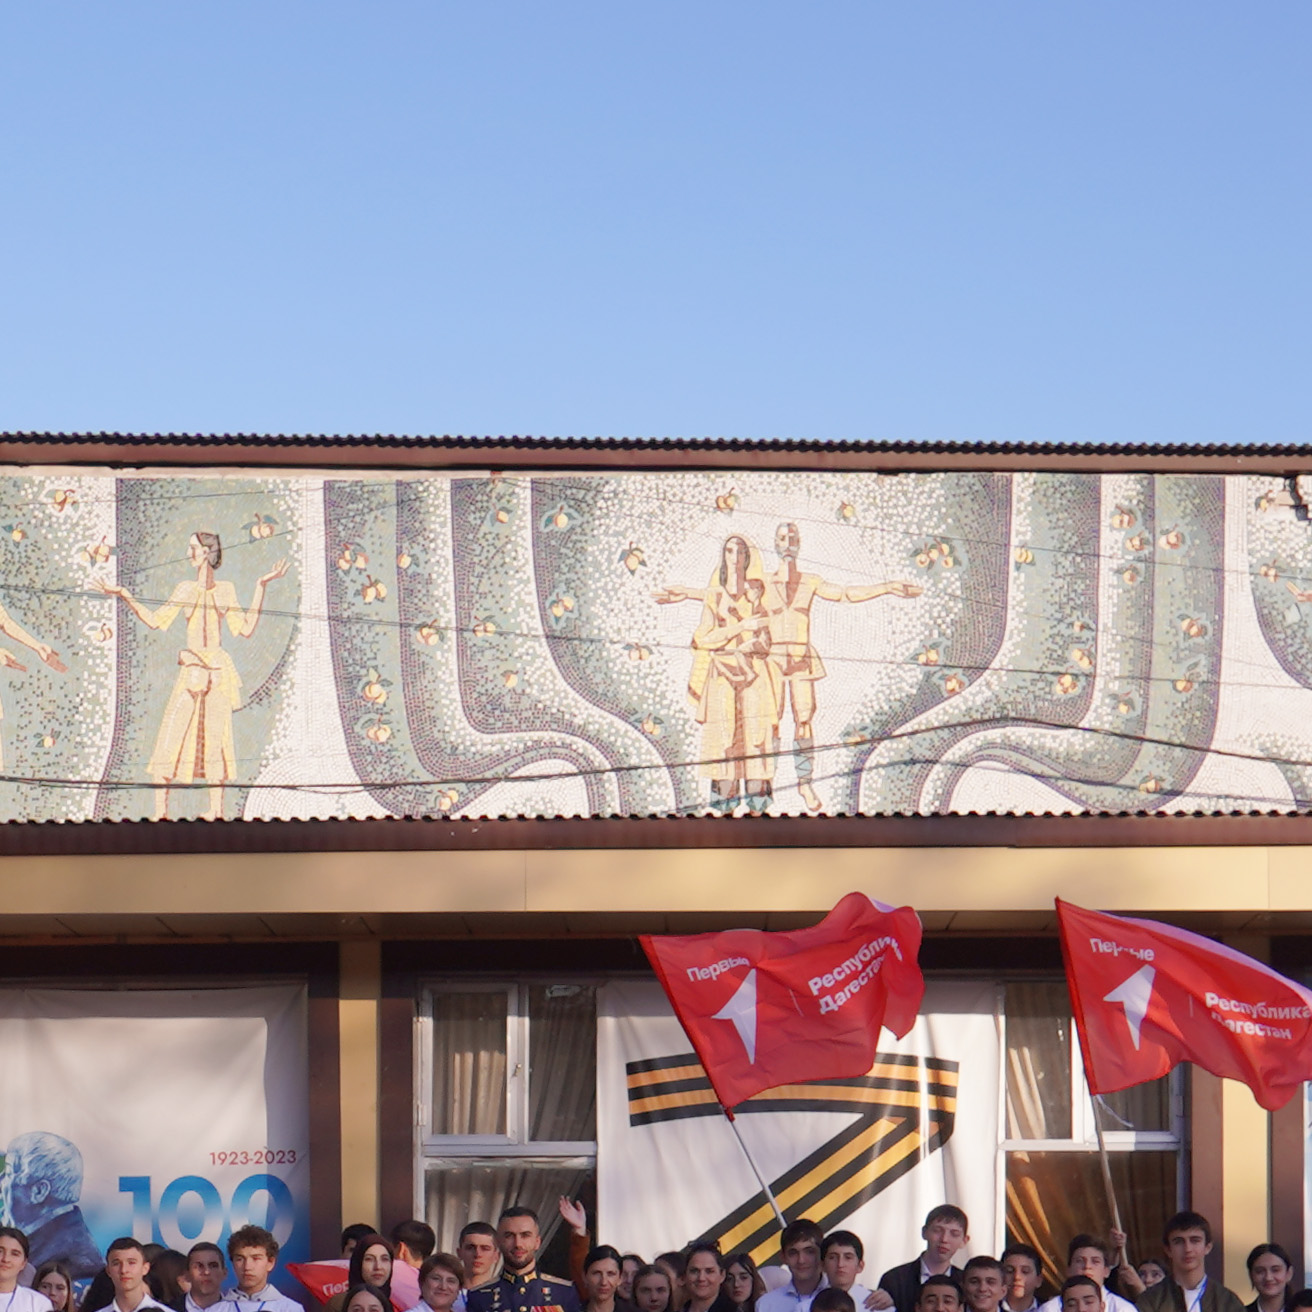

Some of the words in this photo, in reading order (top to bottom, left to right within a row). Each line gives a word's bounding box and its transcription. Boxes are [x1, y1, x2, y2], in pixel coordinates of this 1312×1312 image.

[808, 936, 903, 996] Республик
[1204, 992, 1311, 1020] Республика
[208, 1149, 297, 1167] 1923-2023
[118, 1174, 295, 1251] 100
